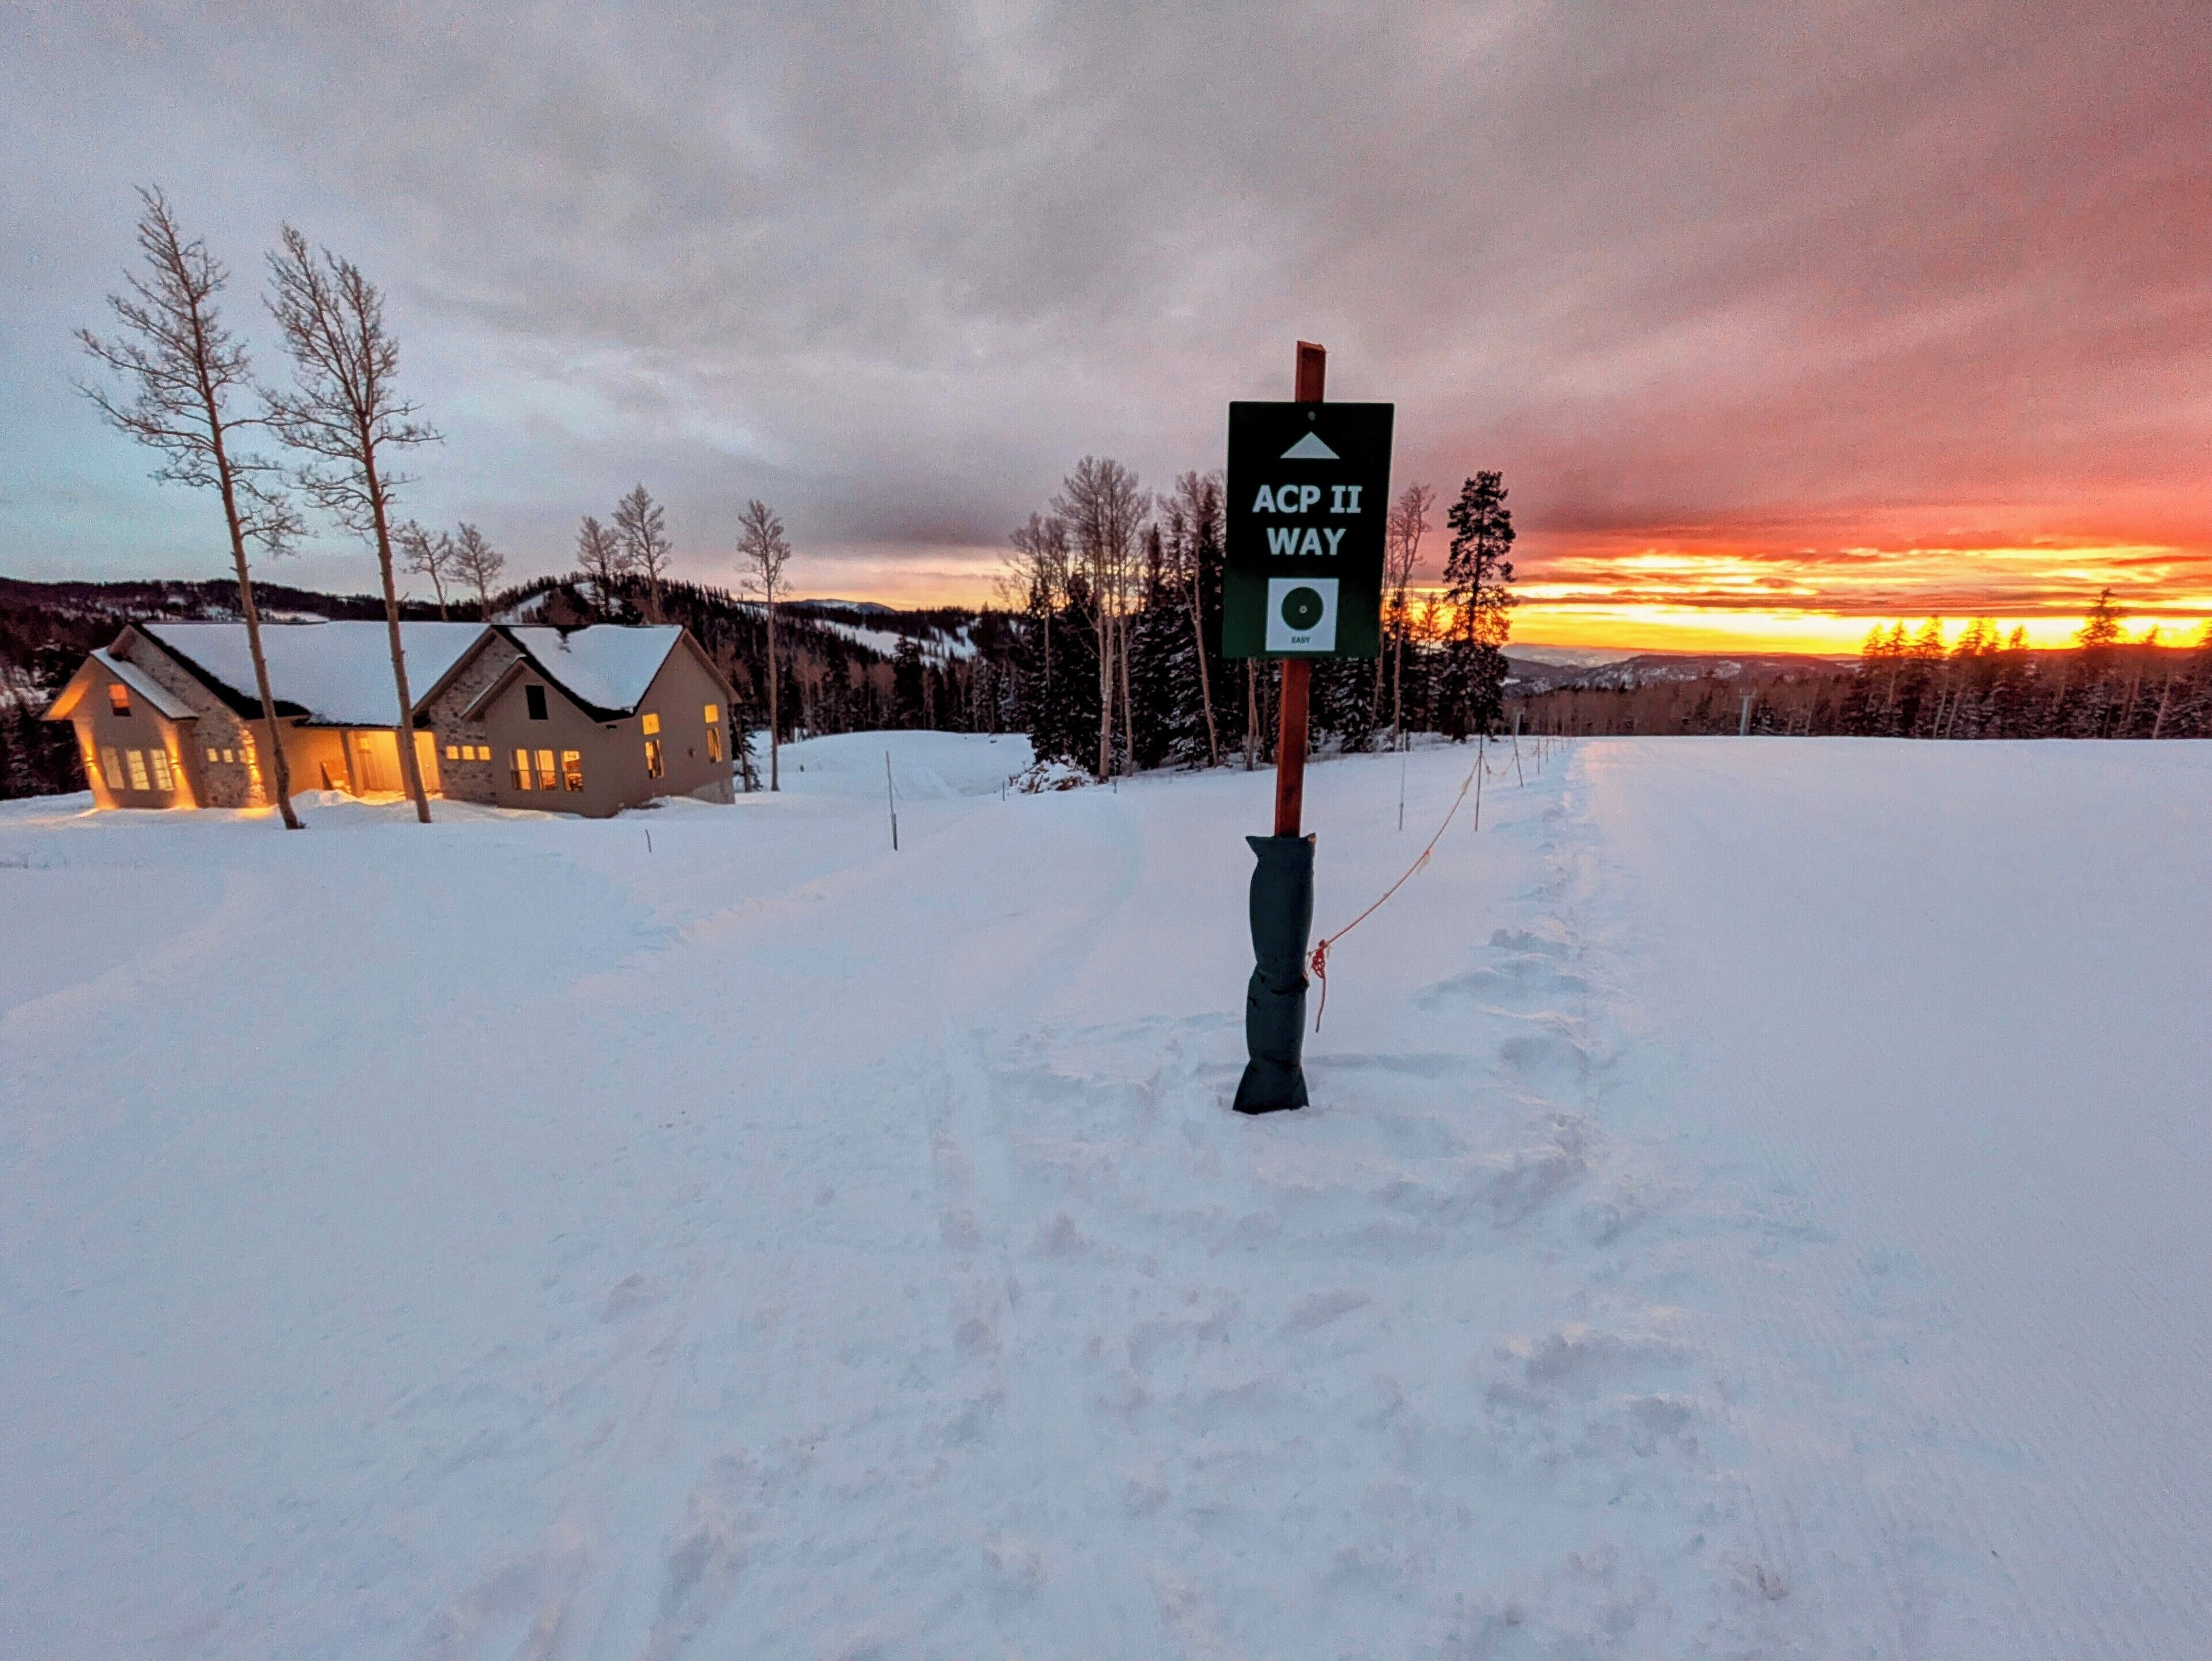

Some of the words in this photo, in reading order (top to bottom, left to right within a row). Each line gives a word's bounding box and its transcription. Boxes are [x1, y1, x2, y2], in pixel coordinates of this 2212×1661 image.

[1252, 485, 1321, 513] ACP
[1330, 485, 1362, 513] II
[1267, 528, 1346, 555] WAY
